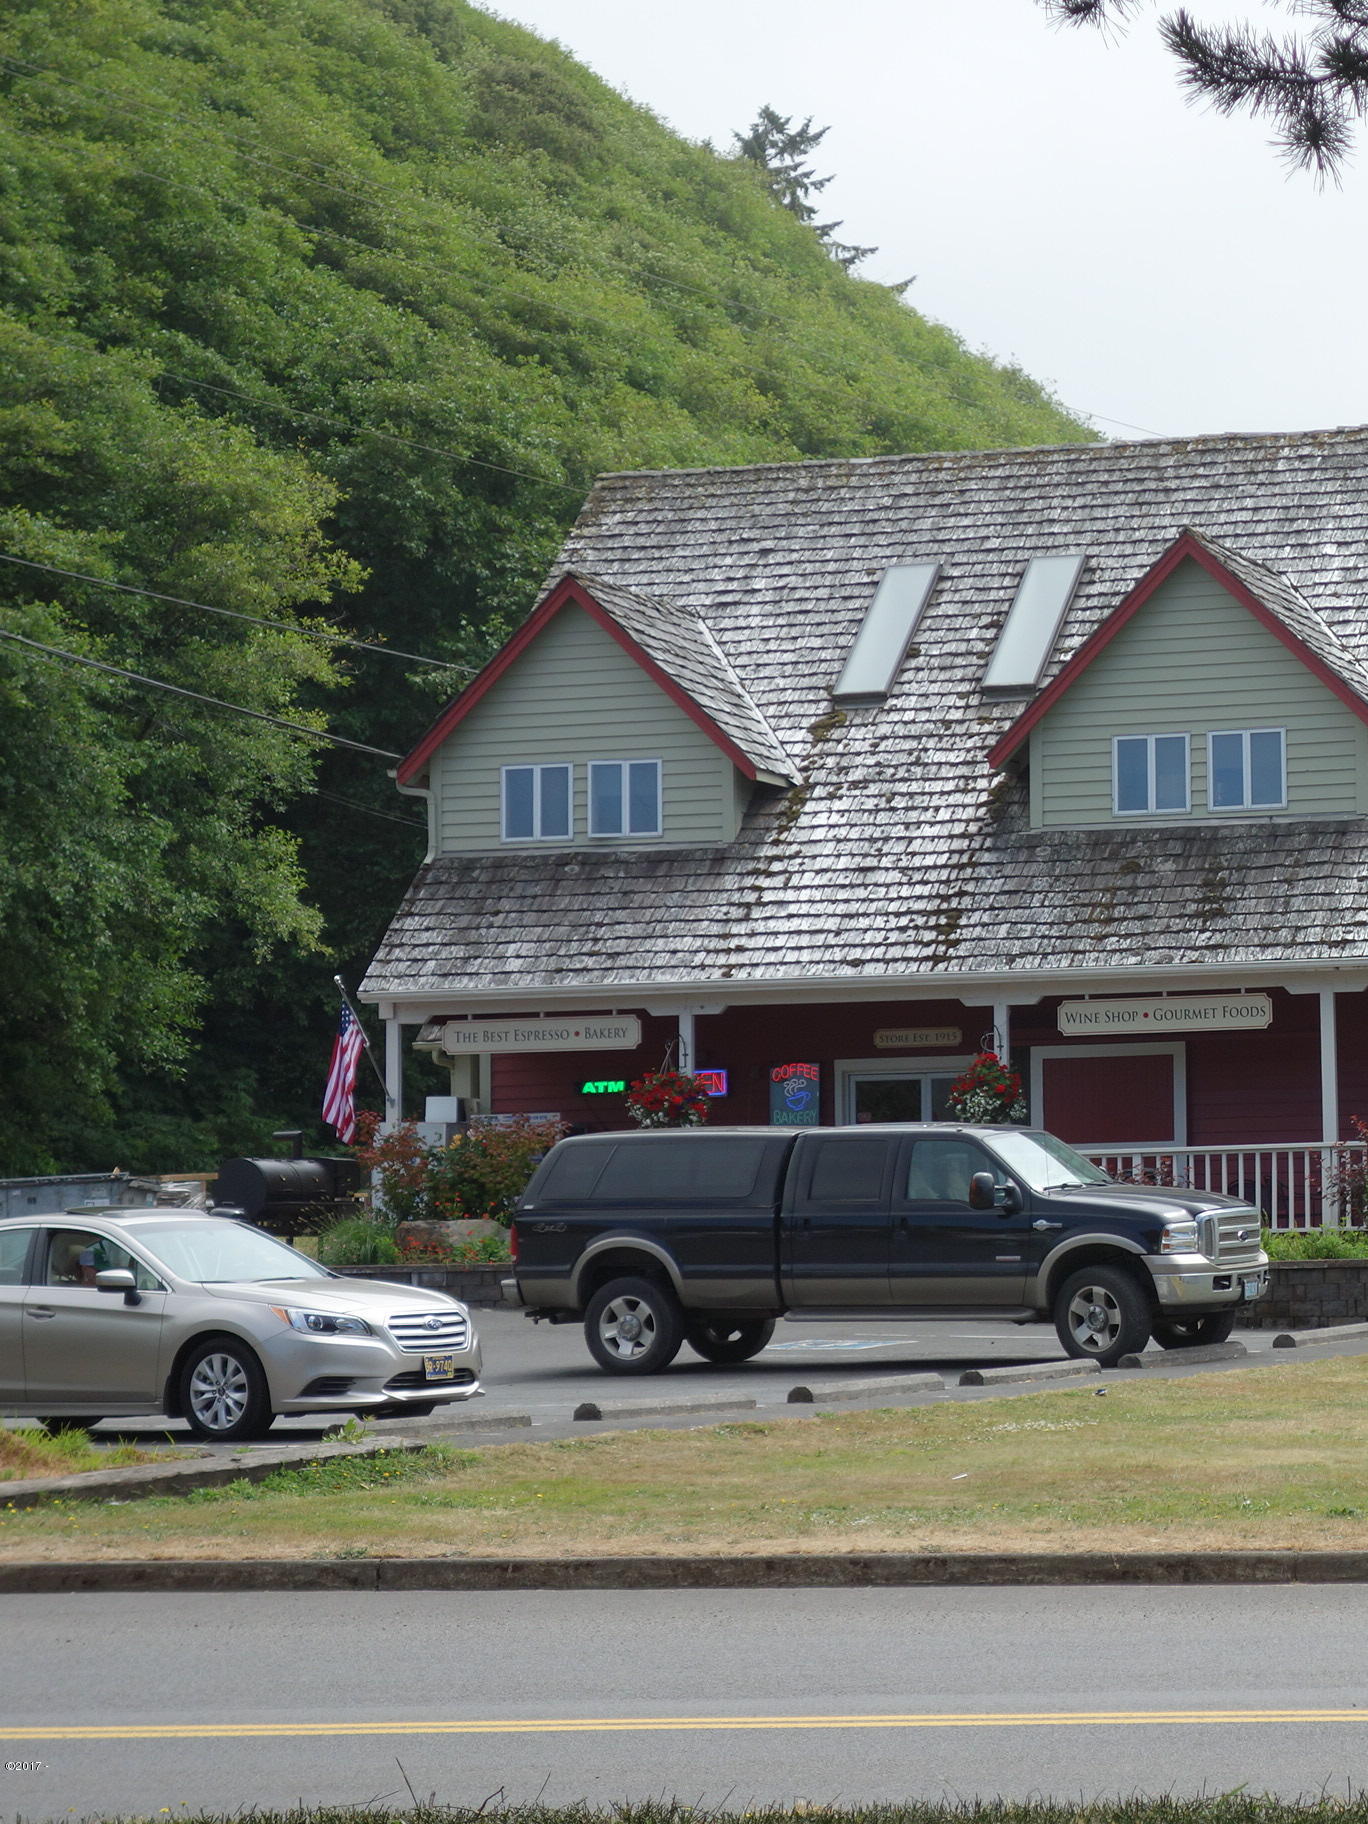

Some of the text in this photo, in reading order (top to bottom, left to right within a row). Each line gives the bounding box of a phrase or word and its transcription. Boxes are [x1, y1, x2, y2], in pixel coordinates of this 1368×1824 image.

[1064, 1004, 1266, 1024] WINE SHOP GOURMET FOODS
[454, 1026, 628, 1043] THE BEST ESPRESSO BAKERY
[772, 1062, 819, 1082] COFFEE
[582, 1080, 624, 1093] ATM
[773, 1110, 818, 1124] BAKERY
